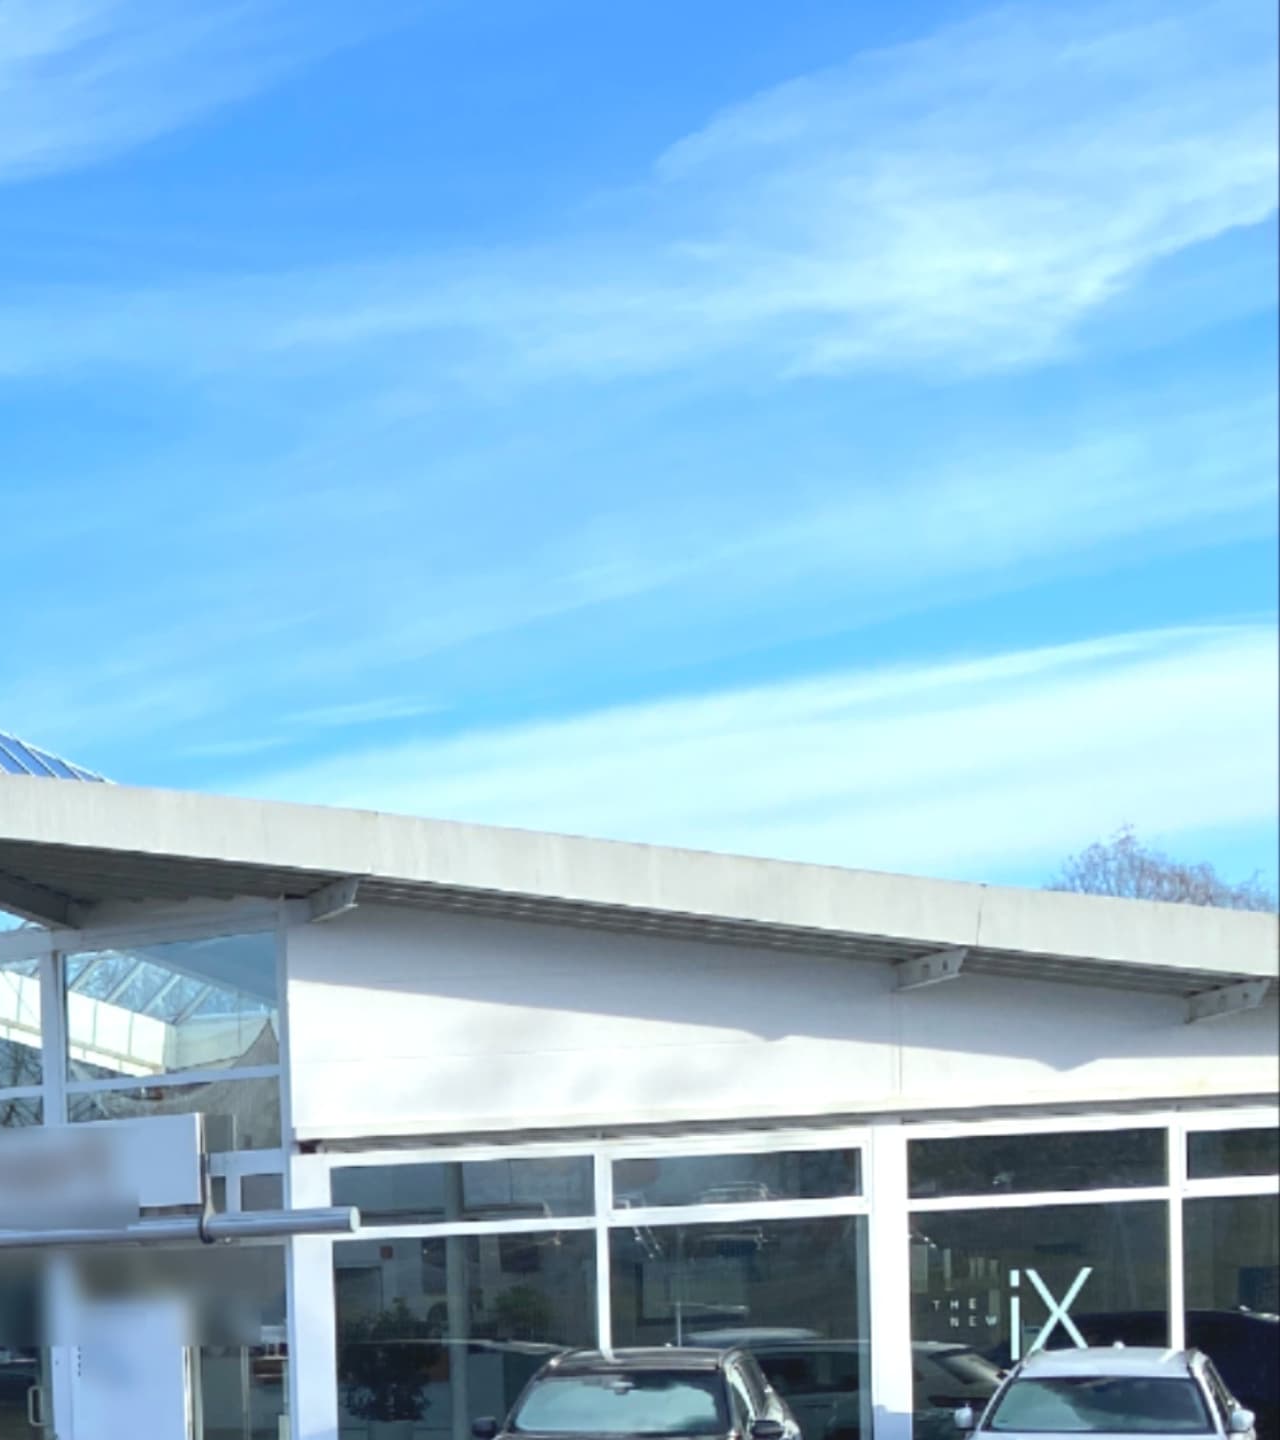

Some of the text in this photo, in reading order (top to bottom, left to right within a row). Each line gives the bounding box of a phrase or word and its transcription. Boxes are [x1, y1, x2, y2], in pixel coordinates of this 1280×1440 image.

[932, 1298, 977, 1310] THE
[1009, 1266, 1094, 1361] iX
[949, 1315, 998, 1328] NEW
